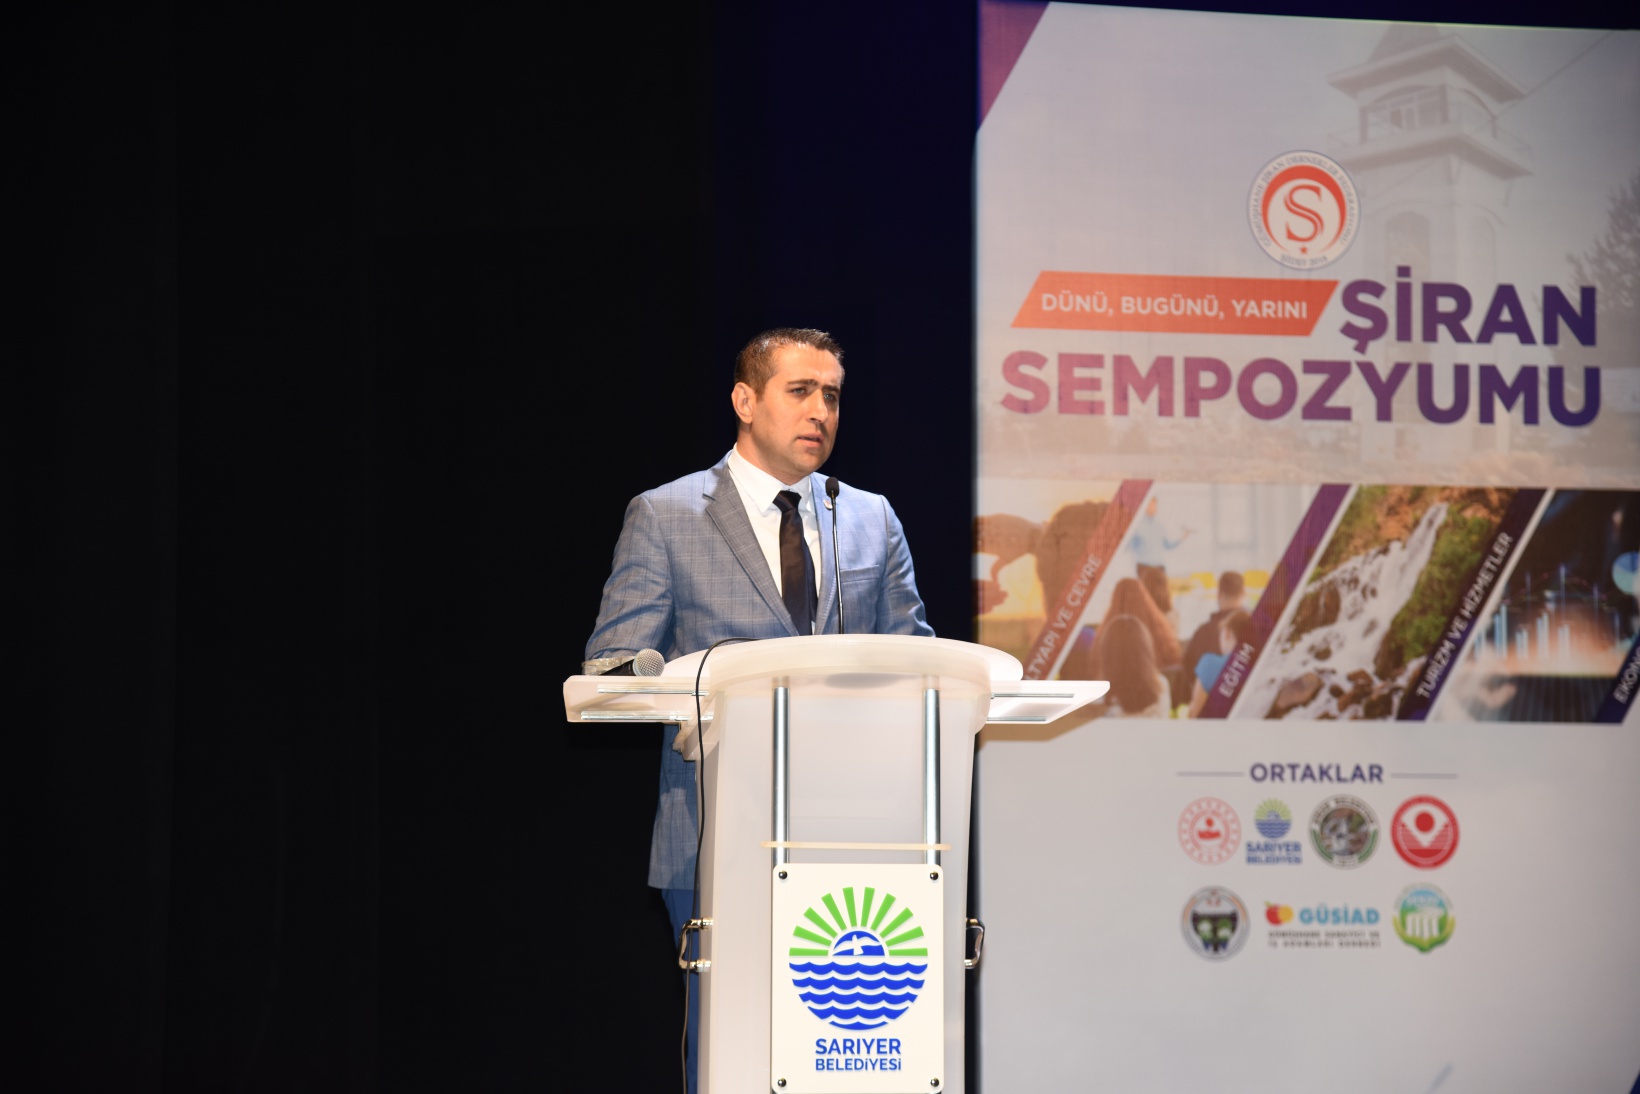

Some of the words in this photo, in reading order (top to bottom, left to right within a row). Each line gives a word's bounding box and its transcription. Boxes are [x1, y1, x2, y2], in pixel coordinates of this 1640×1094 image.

[1041, 289, 1115, 317] DÜNÜ,
[1120, 293, 1225, 321] BUGÜNÜ,
[1231, 299, 1308, 319] YARINI
[1339, 265, 1598, 355] ŞİRAN
[999, 348, 1602, 428] SEMPOZYUMU
[1024, 629, 1061, 681] LTYAPI
[1052, 606, 1074, 629] VE
[1065, 553, 1102, 608] ÇEVRE
[1416, 639, 1457, 698] TURİZM
[1447, 615, 1469, 640] VE
[1459, 531, 1514, 620] HİZMETLER
[1249, 762, 1385, 784] ORTAKLAR
[1298, 902, 1381, 926] GÜSİAD
[815, 1038, 902, 1055] SARIYER
